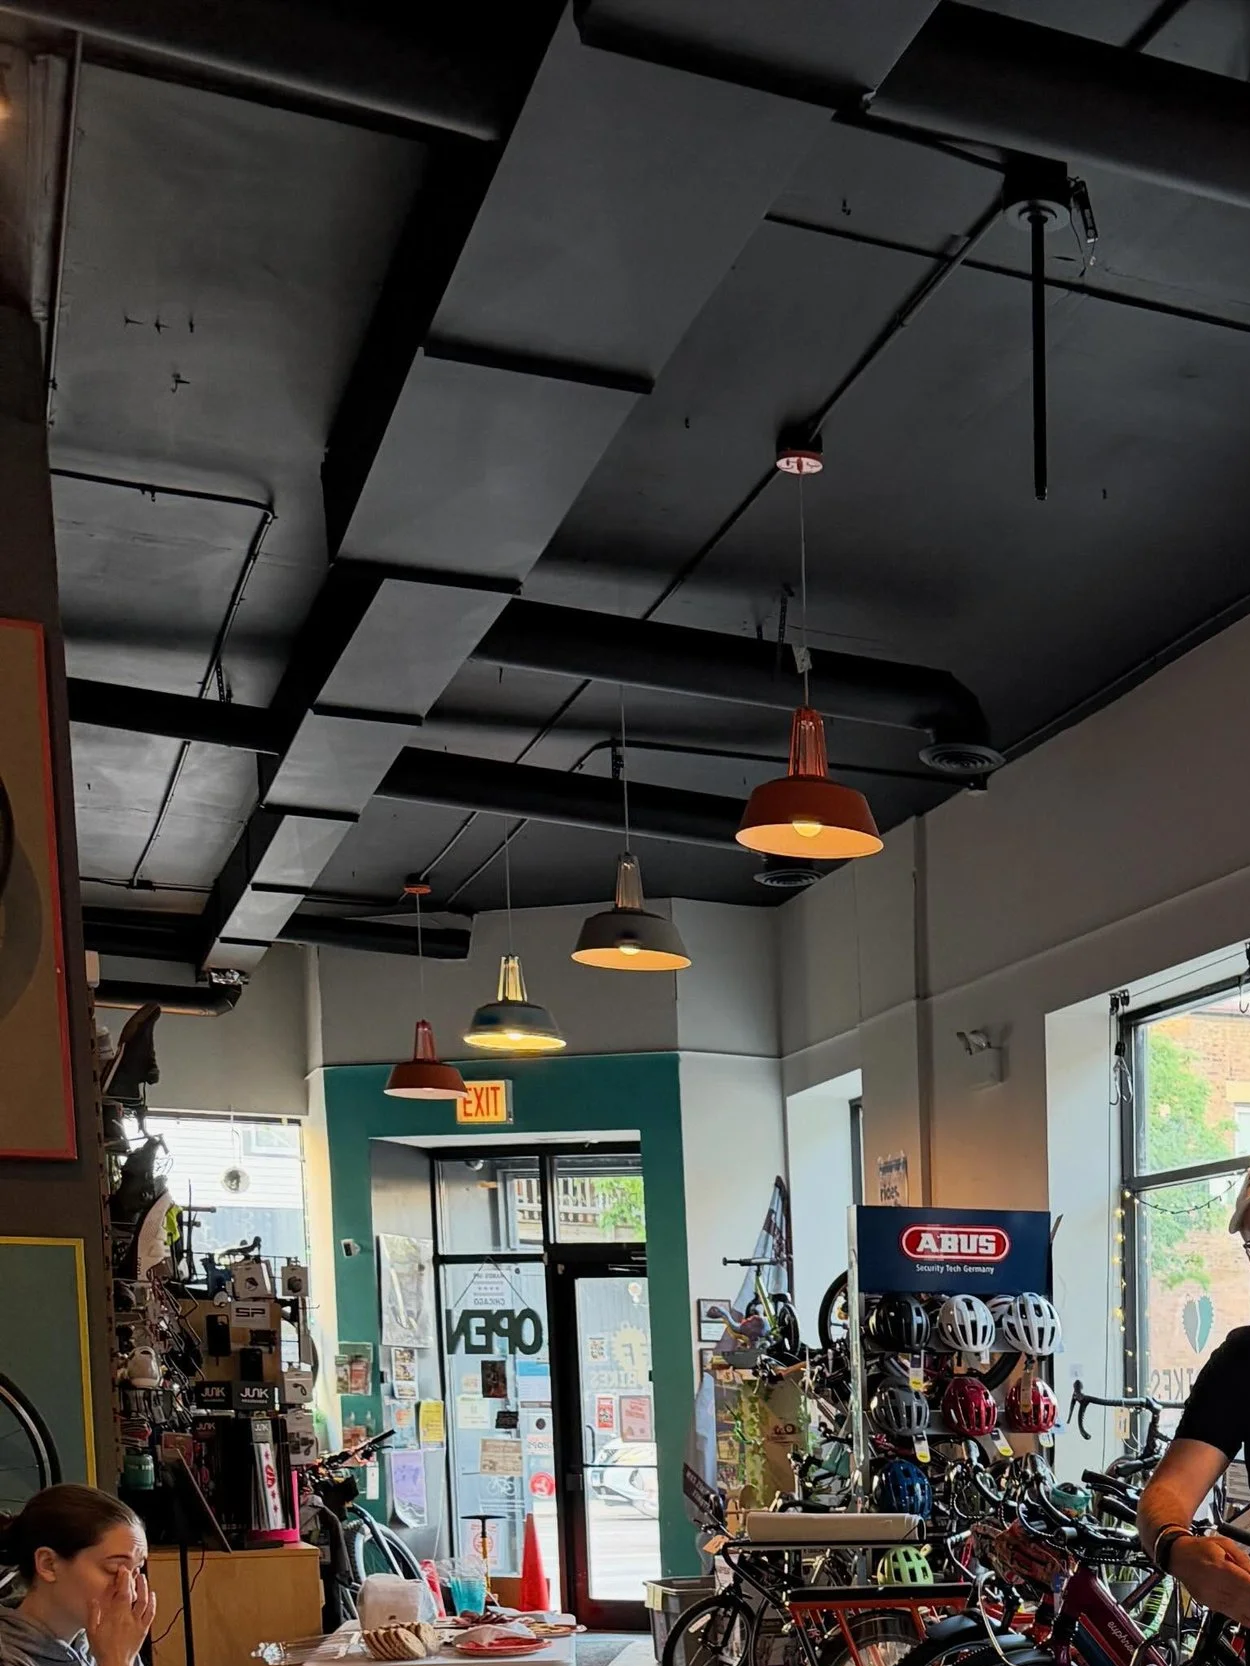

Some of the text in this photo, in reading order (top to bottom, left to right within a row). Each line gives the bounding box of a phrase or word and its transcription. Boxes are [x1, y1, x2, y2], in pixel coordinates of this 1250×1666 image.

[462, 1086, 501, 1118] EXIT
[916, 1232, 996, 1254] ABUS
[916, 1264, 995, 1275] Security Tech Germany
[235, 1307, 266, 1318] SP
[240, 1387, 269, 1399] JUNK
